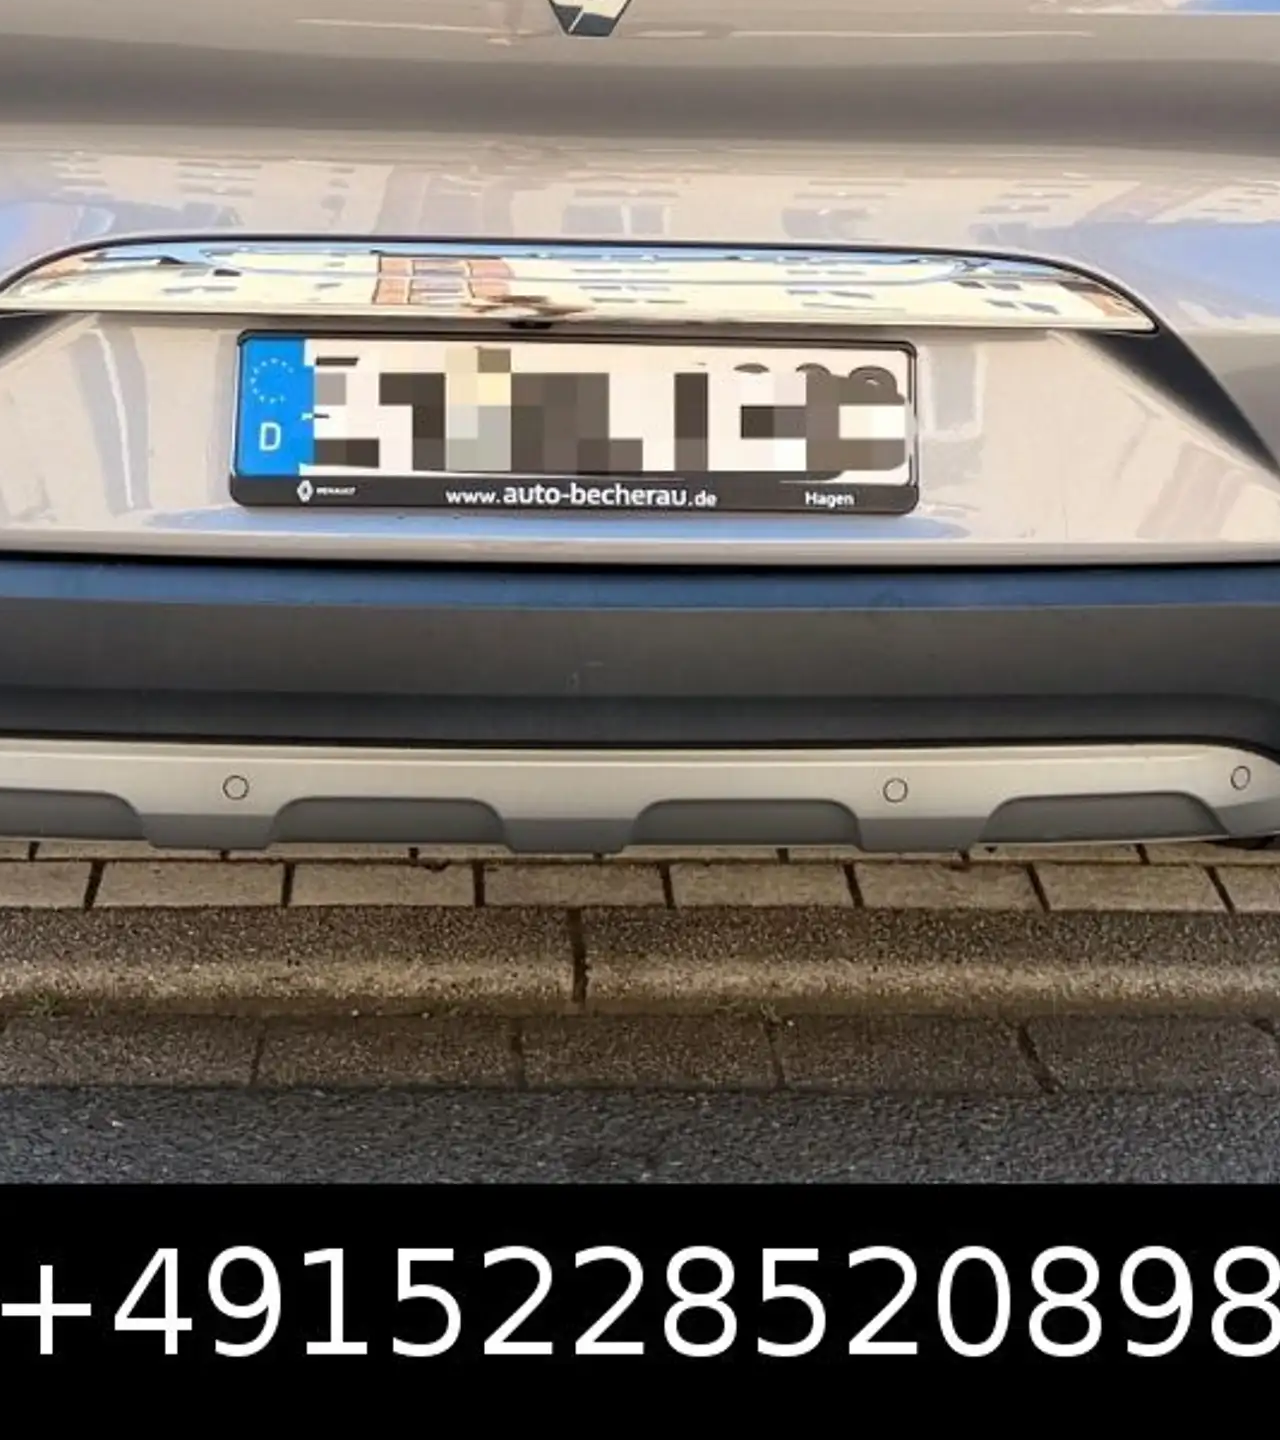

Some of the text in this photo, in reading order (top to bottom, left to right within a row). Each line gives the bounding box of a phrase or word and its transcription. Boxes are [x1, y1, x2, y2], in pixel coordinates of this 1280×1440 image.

[259, 421, 282, 452] D
[445, 481, 718, 508] www.auto-becherau.de
[804, 491, 856, 508] Hagen
